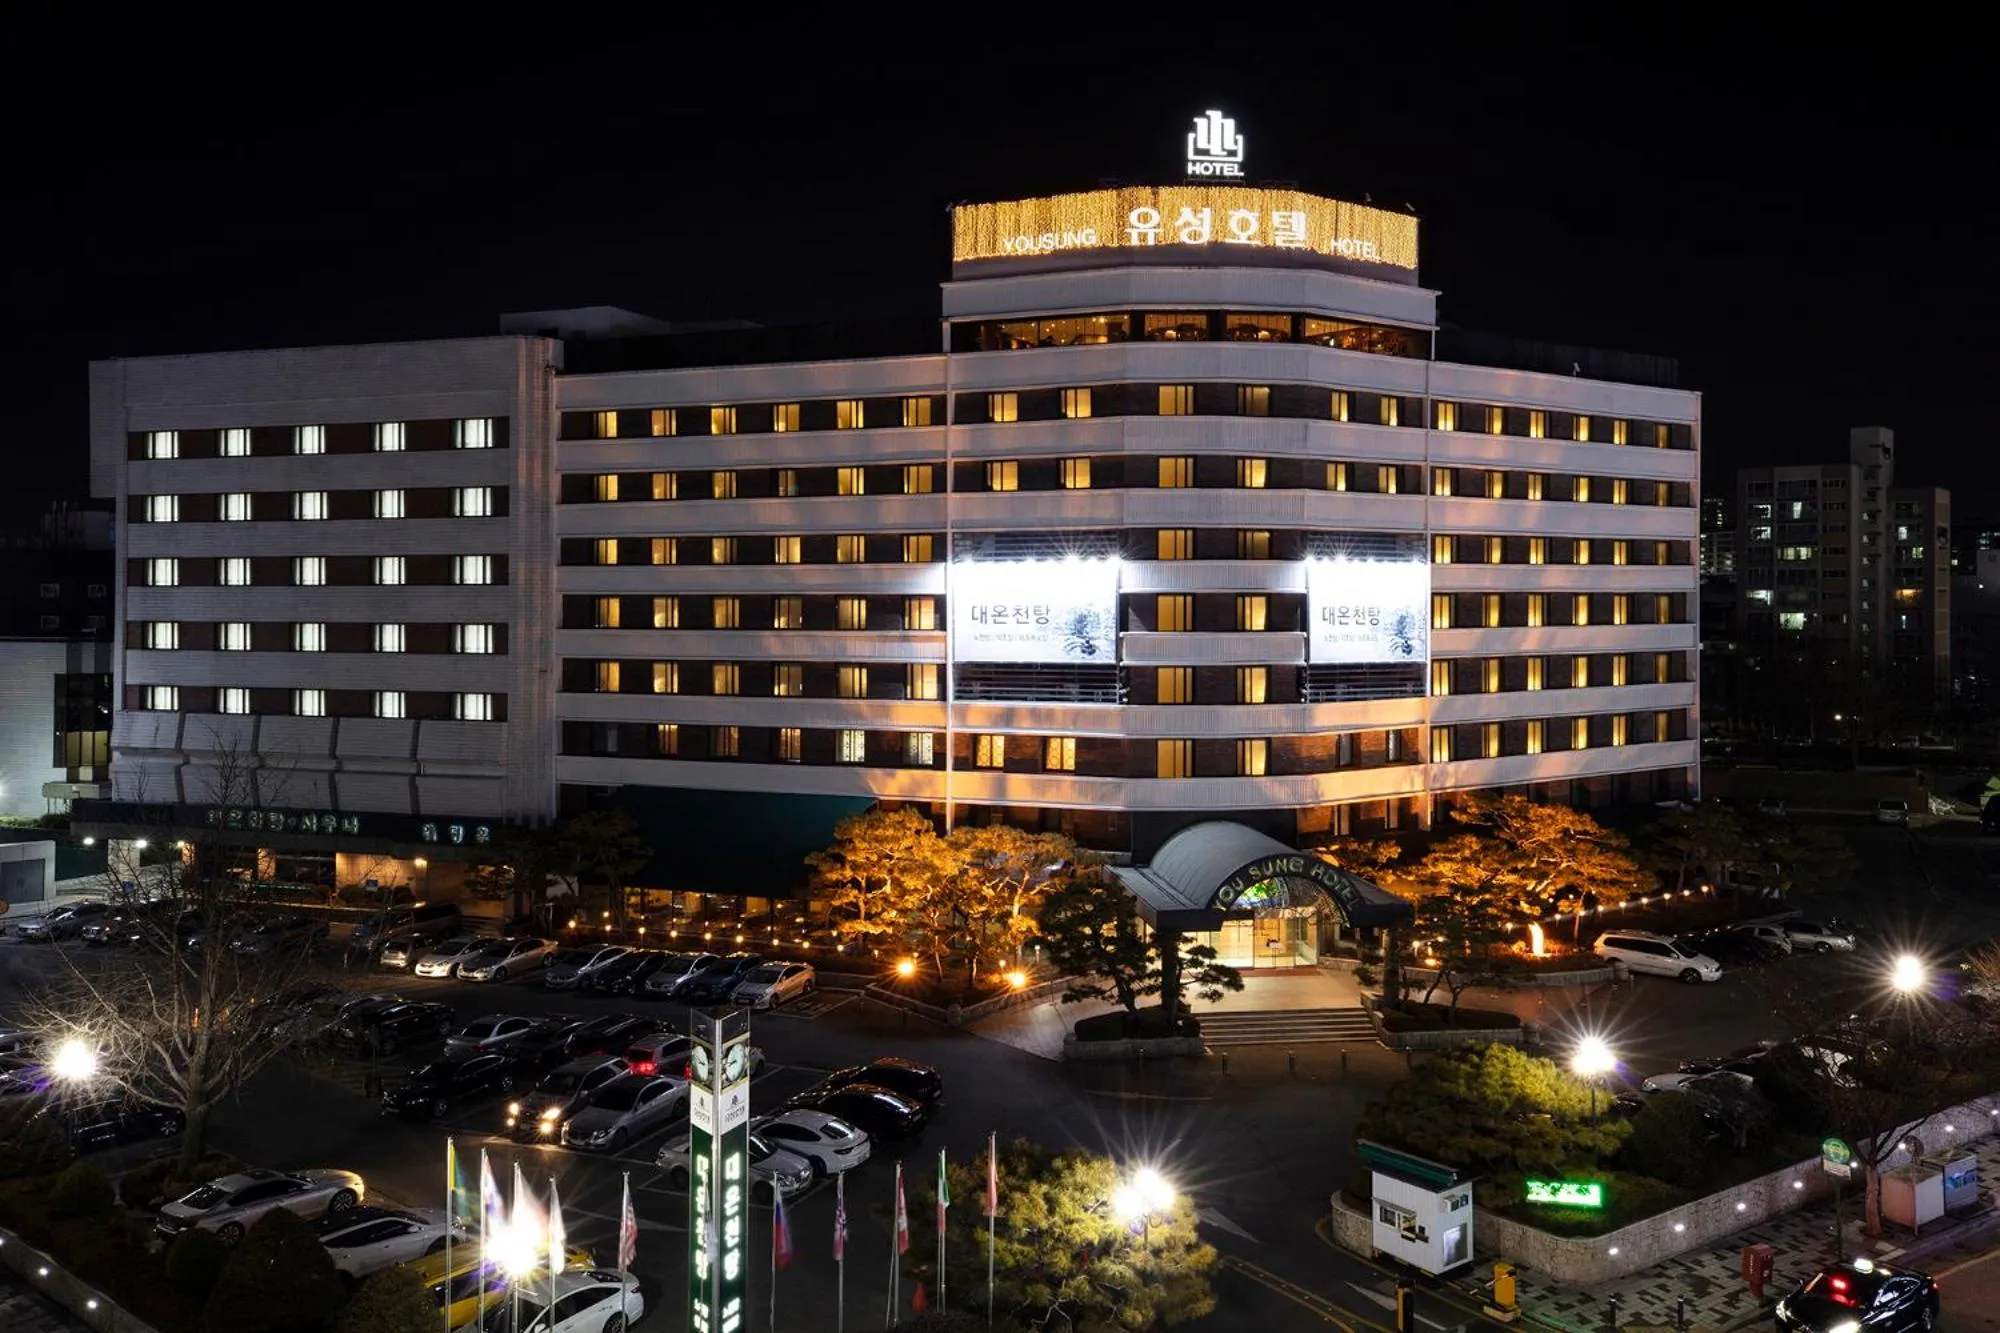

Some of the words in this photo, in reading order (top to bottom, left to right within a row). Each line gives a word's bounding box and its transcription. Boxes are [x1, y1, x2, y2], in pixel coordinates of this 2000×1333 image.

[1187, 161, 1244, 176] HOTEL
[1124, 206, 1309, 247] 유성호텔
[1002, 228, 1098, 255] YOUSUNG
[1330, 238, 1382, 261] HOTEL
[971, 603, 1052, 626] 대온천탕
[1321, 606, 1382, 627] 대온천탕
[1212, 877, 1245, 912] YOU
[1248, 856, 1304, 881] SUNG
[1310, 862, 1361, 912] HOTEL
